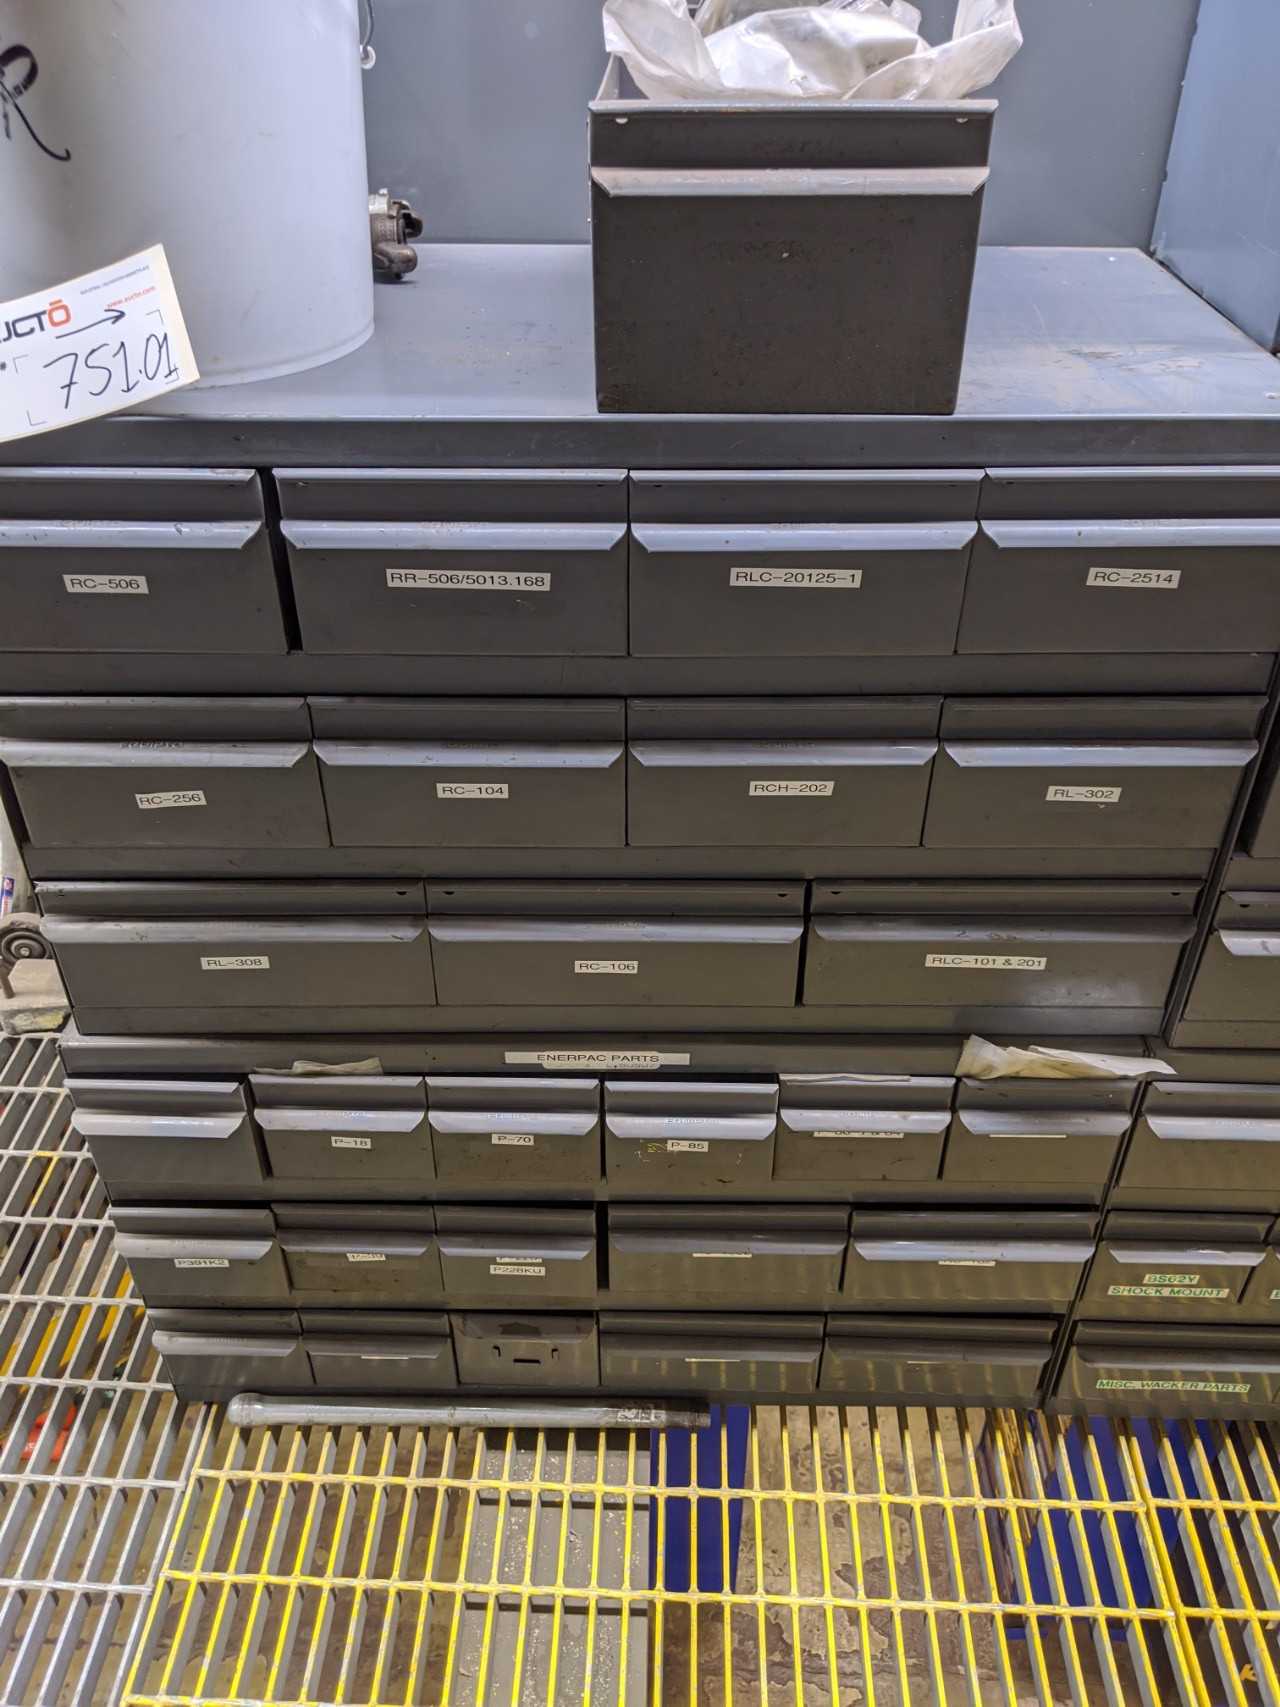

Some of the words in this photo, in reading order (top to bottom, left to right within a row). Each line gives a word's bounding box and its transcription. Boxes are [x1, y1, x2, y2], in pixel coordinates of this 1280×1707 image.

[43, 332, 179, 409] 751.01
[390, 572, 546, 587] RR-506/5013.168
[735, 571, 856, 584] RLC-20125-1
[1093, 571, 1174, 584] RC-2514
[70, 578, 140, 590] RC-506
[441, 786, 504, 795] RC-104
[754, 784, 828, 793] RCH-202
[1054, 789, 1114, 799] RL-302
[138, 793, 201, 806] RC-256
[206, 958, 263, 967] RL-308
[579, 962, 636, 971] RC-106
[931, 957, 997, 966] RLC-101
[1002, 958, 1013, 966] &
[1016, 959, 1042, 967] 201
[536, 1054, 607, 1062] ENERPAC
[611, 1055, 660, 1063] PARTS
[334, 1138, 368, 1147] P-18
[497, 1135, 532, 1144] P-70
[671, 1141, 705, 1149] P-85
[1111, 1287, 1164, 1296] SHOCK
[1168, 1288, 1226, 1297] MOUNT
[1140, 1381, 1200, 1390] WACKER
[1202, 1383, 1249, 1392] PARTS
